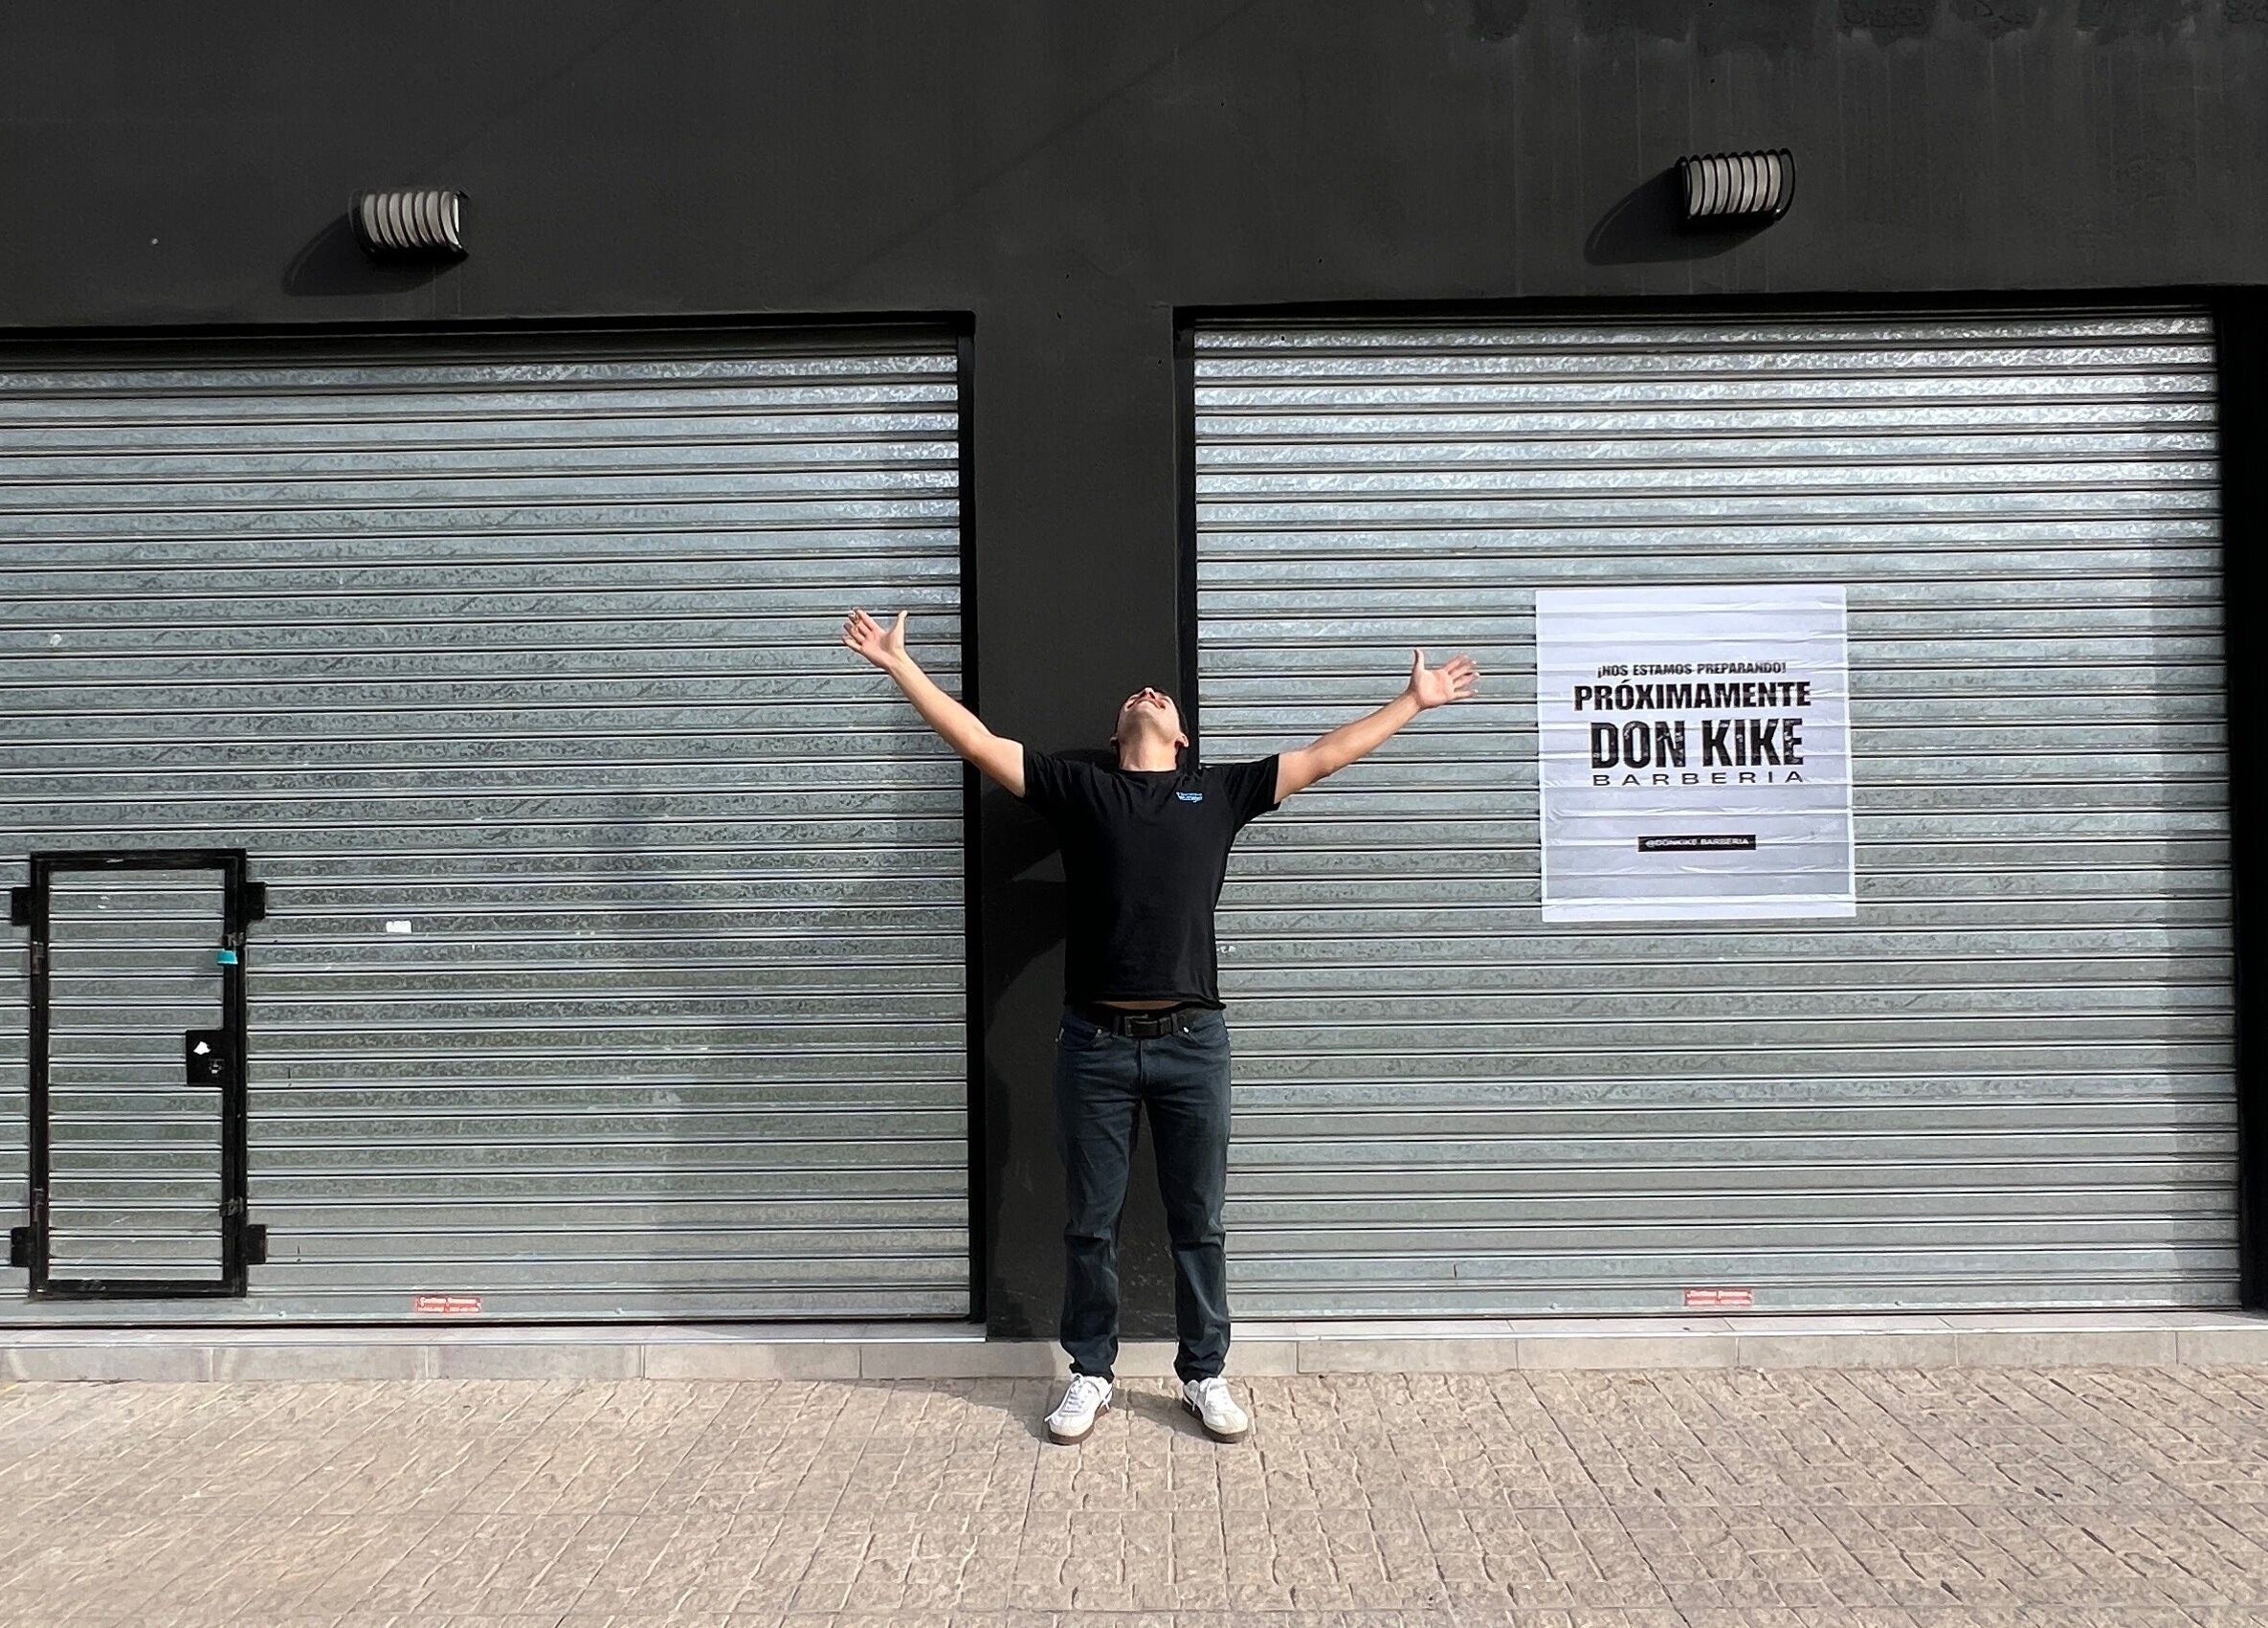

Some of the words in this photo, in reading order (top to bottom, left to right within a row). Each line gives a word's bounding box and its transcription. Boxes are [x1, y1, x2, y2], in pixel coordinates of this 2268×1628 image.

[1597, 664, 1629, 679] ¡NOS
[1633, 663, 1692, 676] ESTAMOS
[1697, 661, 1787, 674] PREPARANDO!
[1573, 680, 1812, 711] PRÓXIMAMENTE
[1590, 720, 1685, 769] DON
[1701, 718, 1805, 767] KIKE
[1592, 770, 1804, 786] BARBERIA
